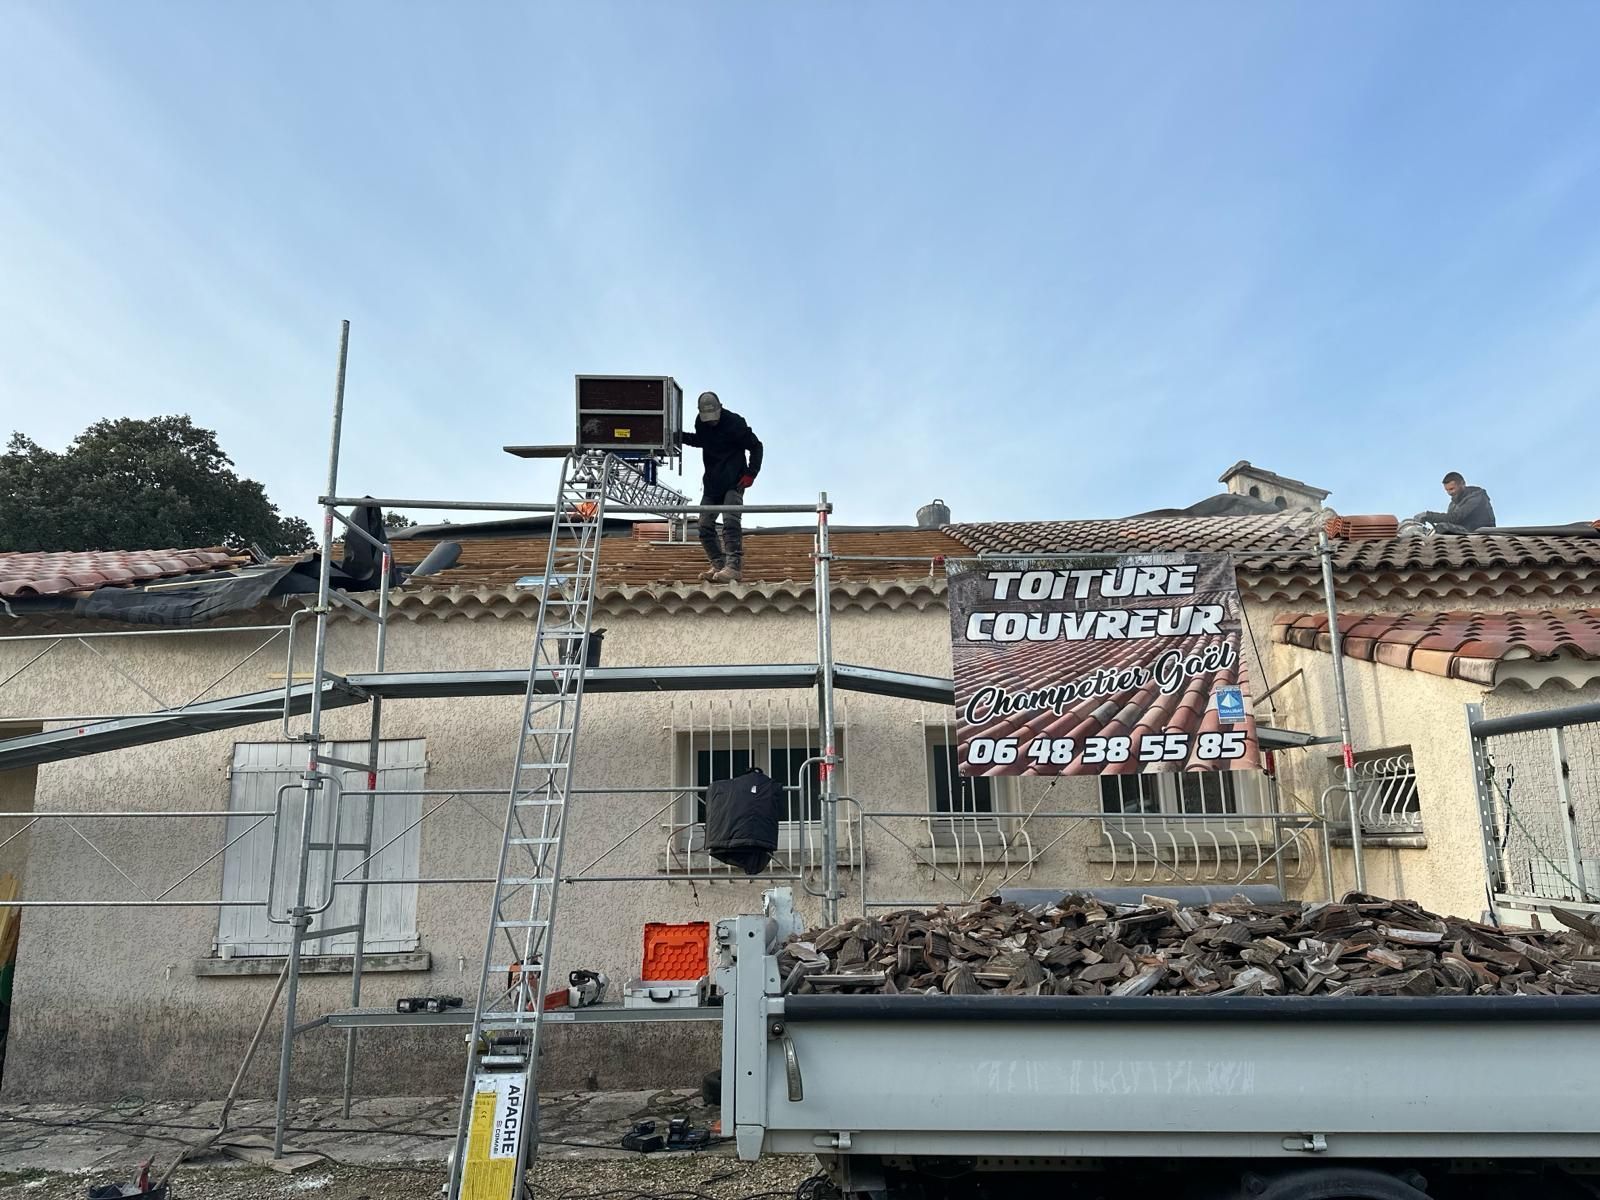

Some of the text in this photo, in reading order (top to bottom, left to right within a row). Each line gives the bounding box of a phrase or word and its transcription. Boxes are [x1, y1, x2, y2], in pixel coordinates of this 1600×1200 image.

[988, 565, 1198, 601] TOITURE
[967, 605, 1224, 642] COUVREUR
[966, 642, 1236, 726] Champetier Gaël
[967, 731, 1247, 765] 06 48 38 55 85
[502, 1085, 520, 1153] APACHE
